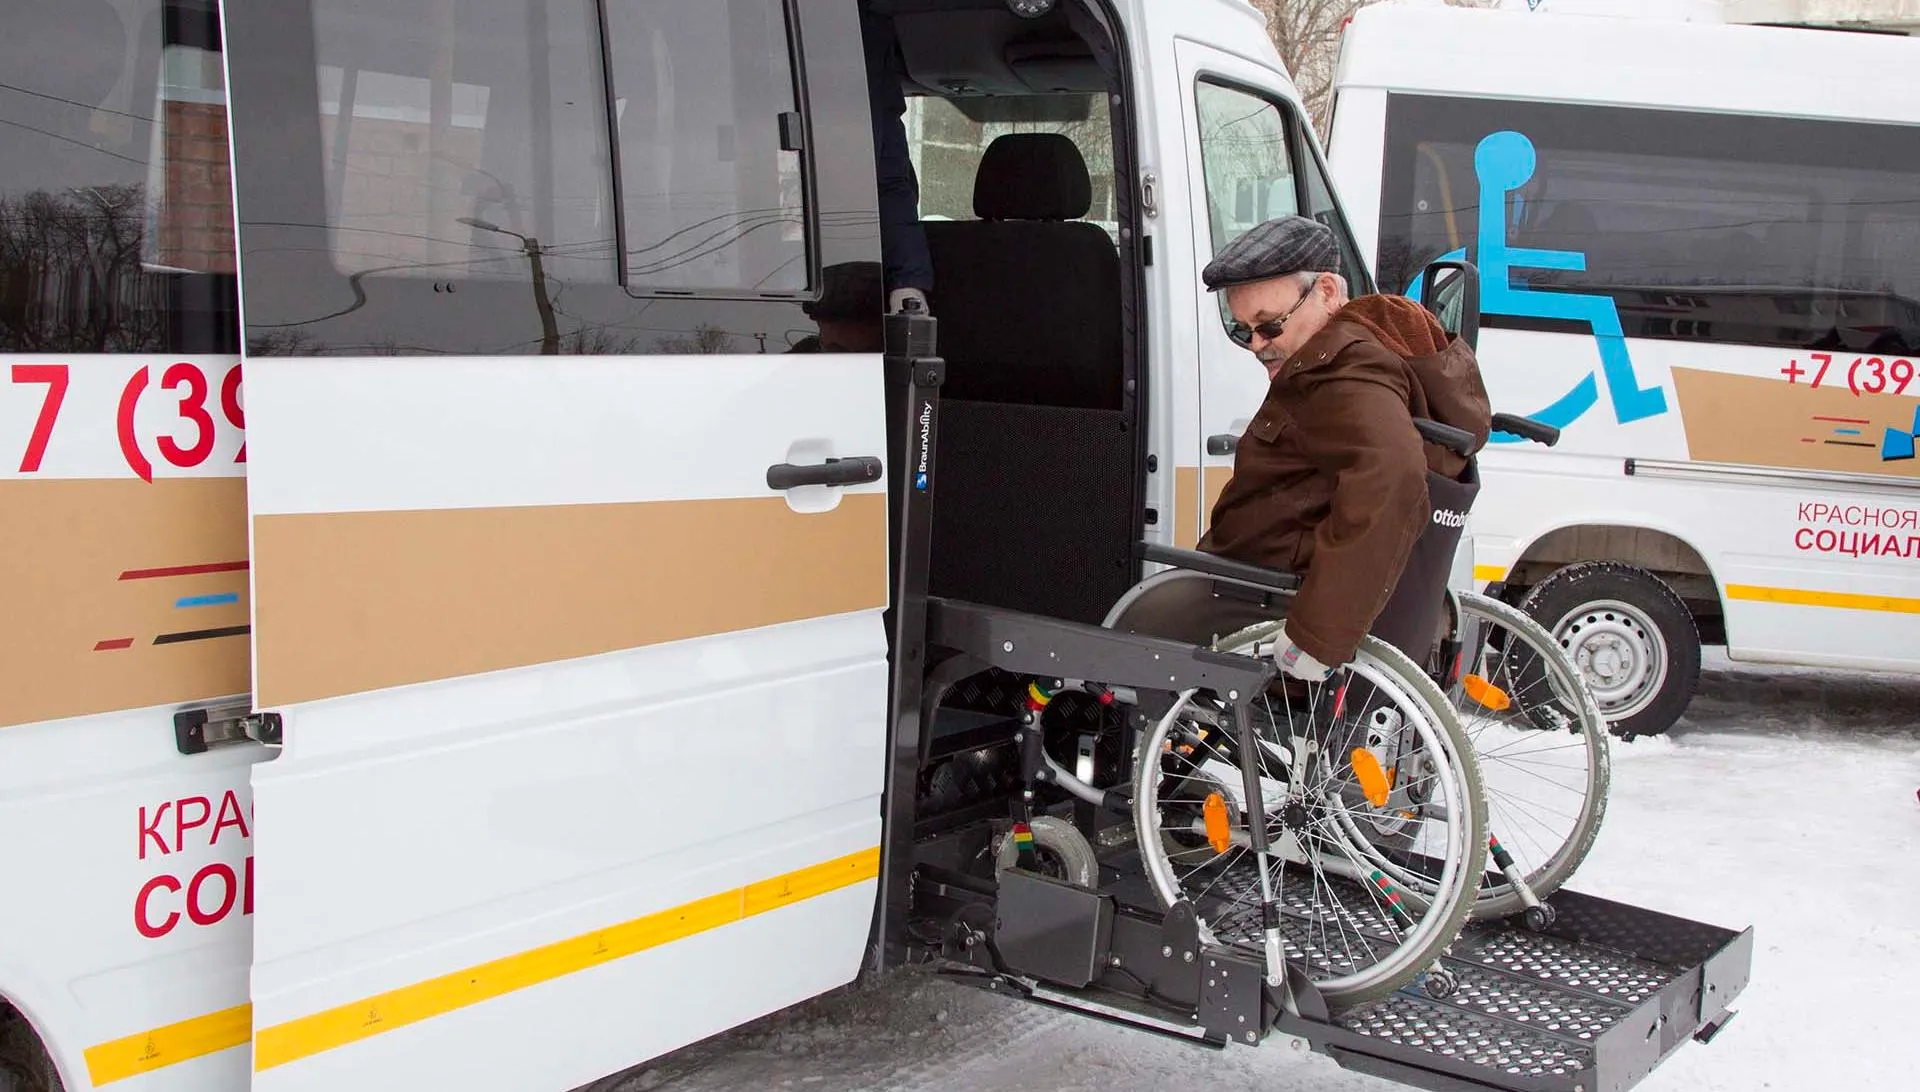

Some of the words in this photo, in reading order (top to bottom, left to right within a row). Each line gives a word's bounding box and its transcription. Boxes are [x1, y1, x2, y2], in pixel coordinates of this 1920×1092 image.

[1781, 353, 1832, 389] +7
[1848, 357, 1920, 397] (39
[12, 365, 69, 472] 7
[919, 400, 932, 472] BraunAbility
[1433, 509, 1465, 527] ottob
[1798, 502, 1920, 529] КРАСНОЯ
[1795, 527, 1920, 558] СОЦИАЛ
[138, 790, 254, 860] КРА
